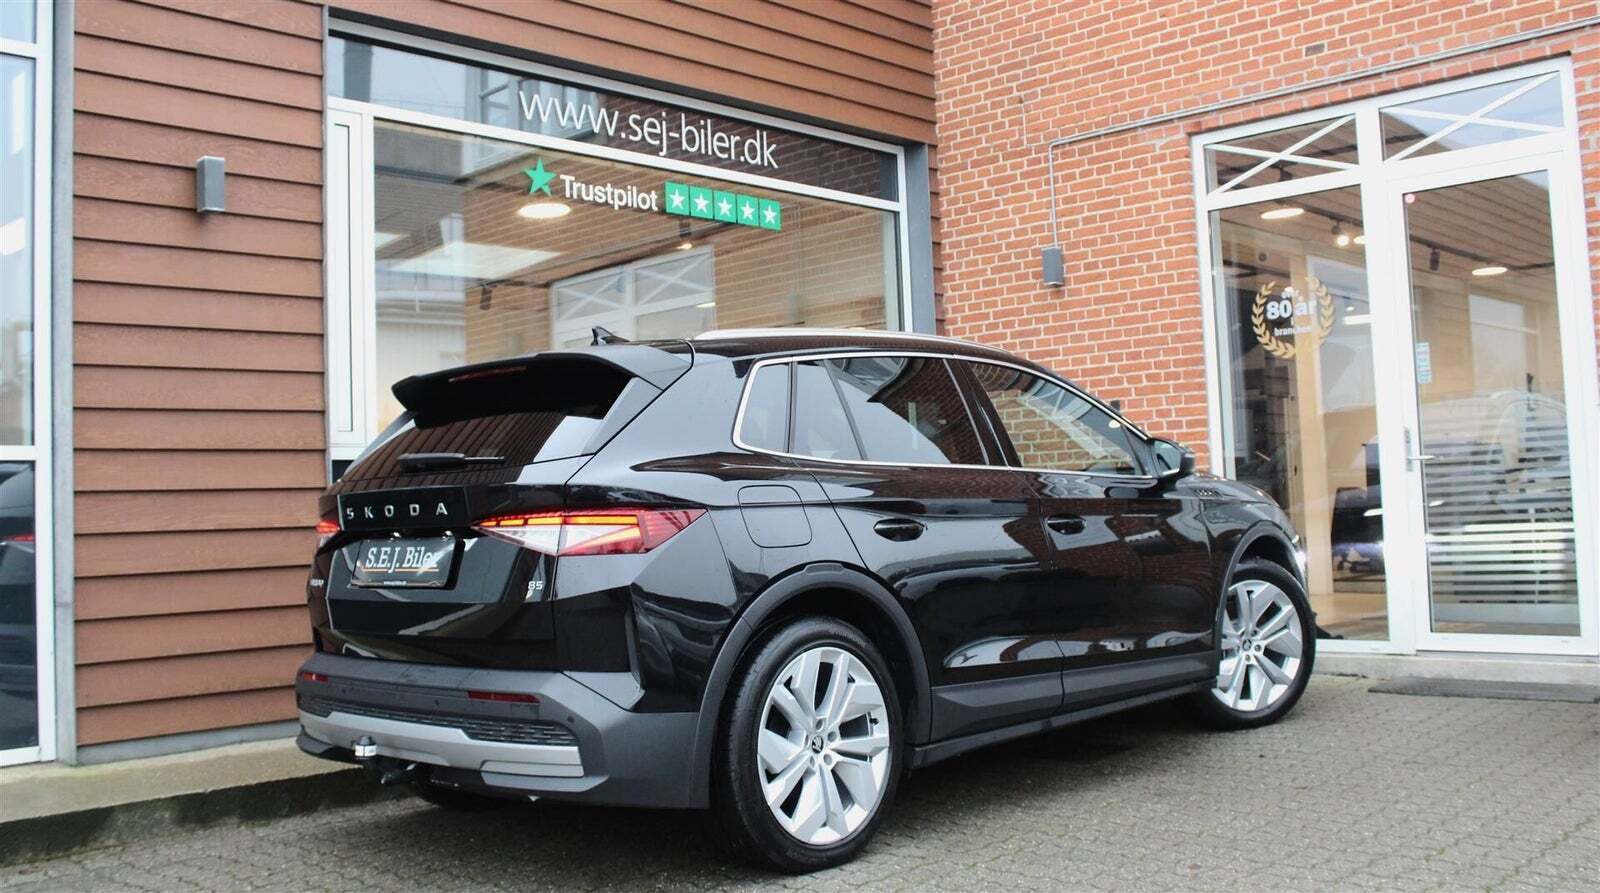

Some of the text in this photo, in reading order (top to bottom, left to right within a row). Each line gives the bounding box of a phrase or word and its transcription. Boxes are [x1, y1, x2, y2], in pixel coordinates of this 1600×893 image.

[519, 90, 779, 169] www.sej-biler.dk
[559, 174, 658, 212] Trustpilot
[1266, 300, 1292, 320] 80
[365, 546, 400, 573] S.E.J.
[528, 580, 543, 590] 85
